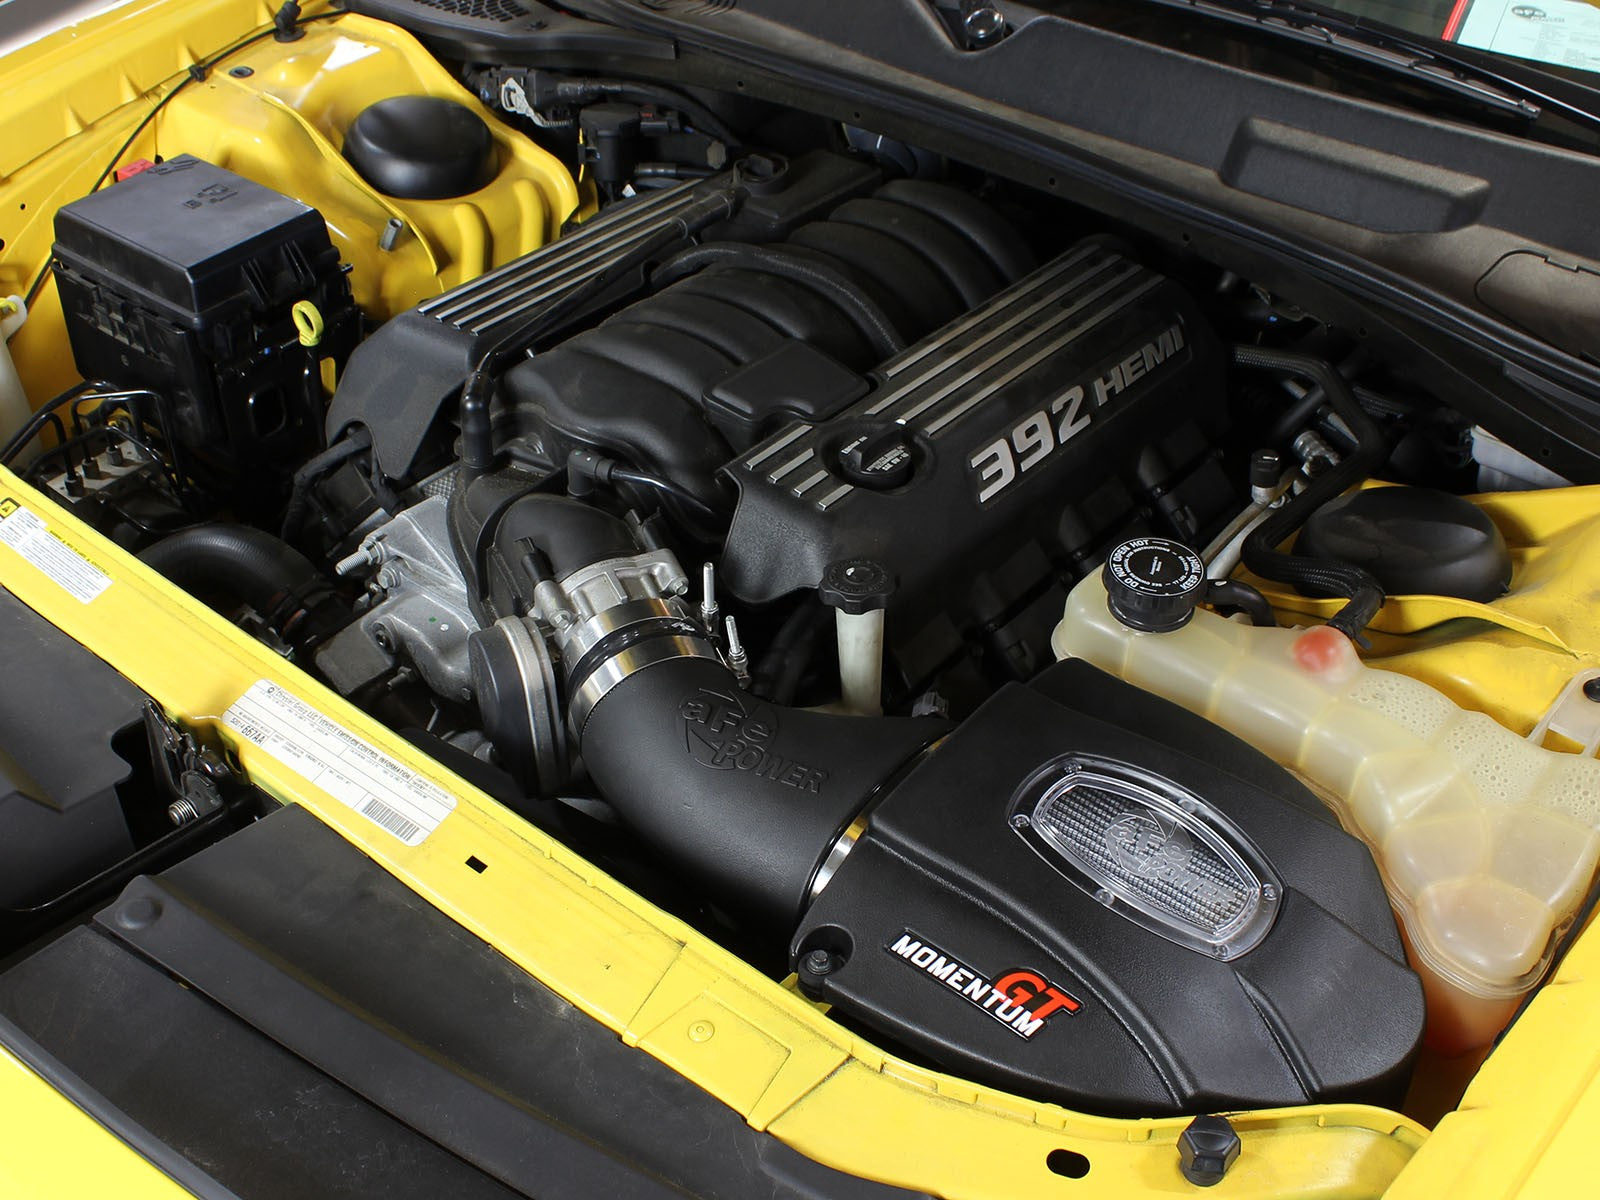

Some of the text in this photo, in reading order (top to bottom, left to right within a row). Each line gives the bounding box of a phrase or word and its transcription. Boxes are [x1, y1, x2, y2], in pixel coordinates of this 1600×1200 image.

[970, 325, 1185, 503] 392 HEMI
[1112, 539, 1149, 588] DO NOT OPEN HOT
[1180, 574, 1198, 590] KEEP
[1186, 556, 1201, 574] TIGHT
[358, 743, 379, 759] CONTROL
[378, 757, 412, 780] INFORMATION
[711, 738, 829, 793] POWER
[890, 934, 1044, 1037] MOMENTUM
[994, 971, 1080, 1020] GT
